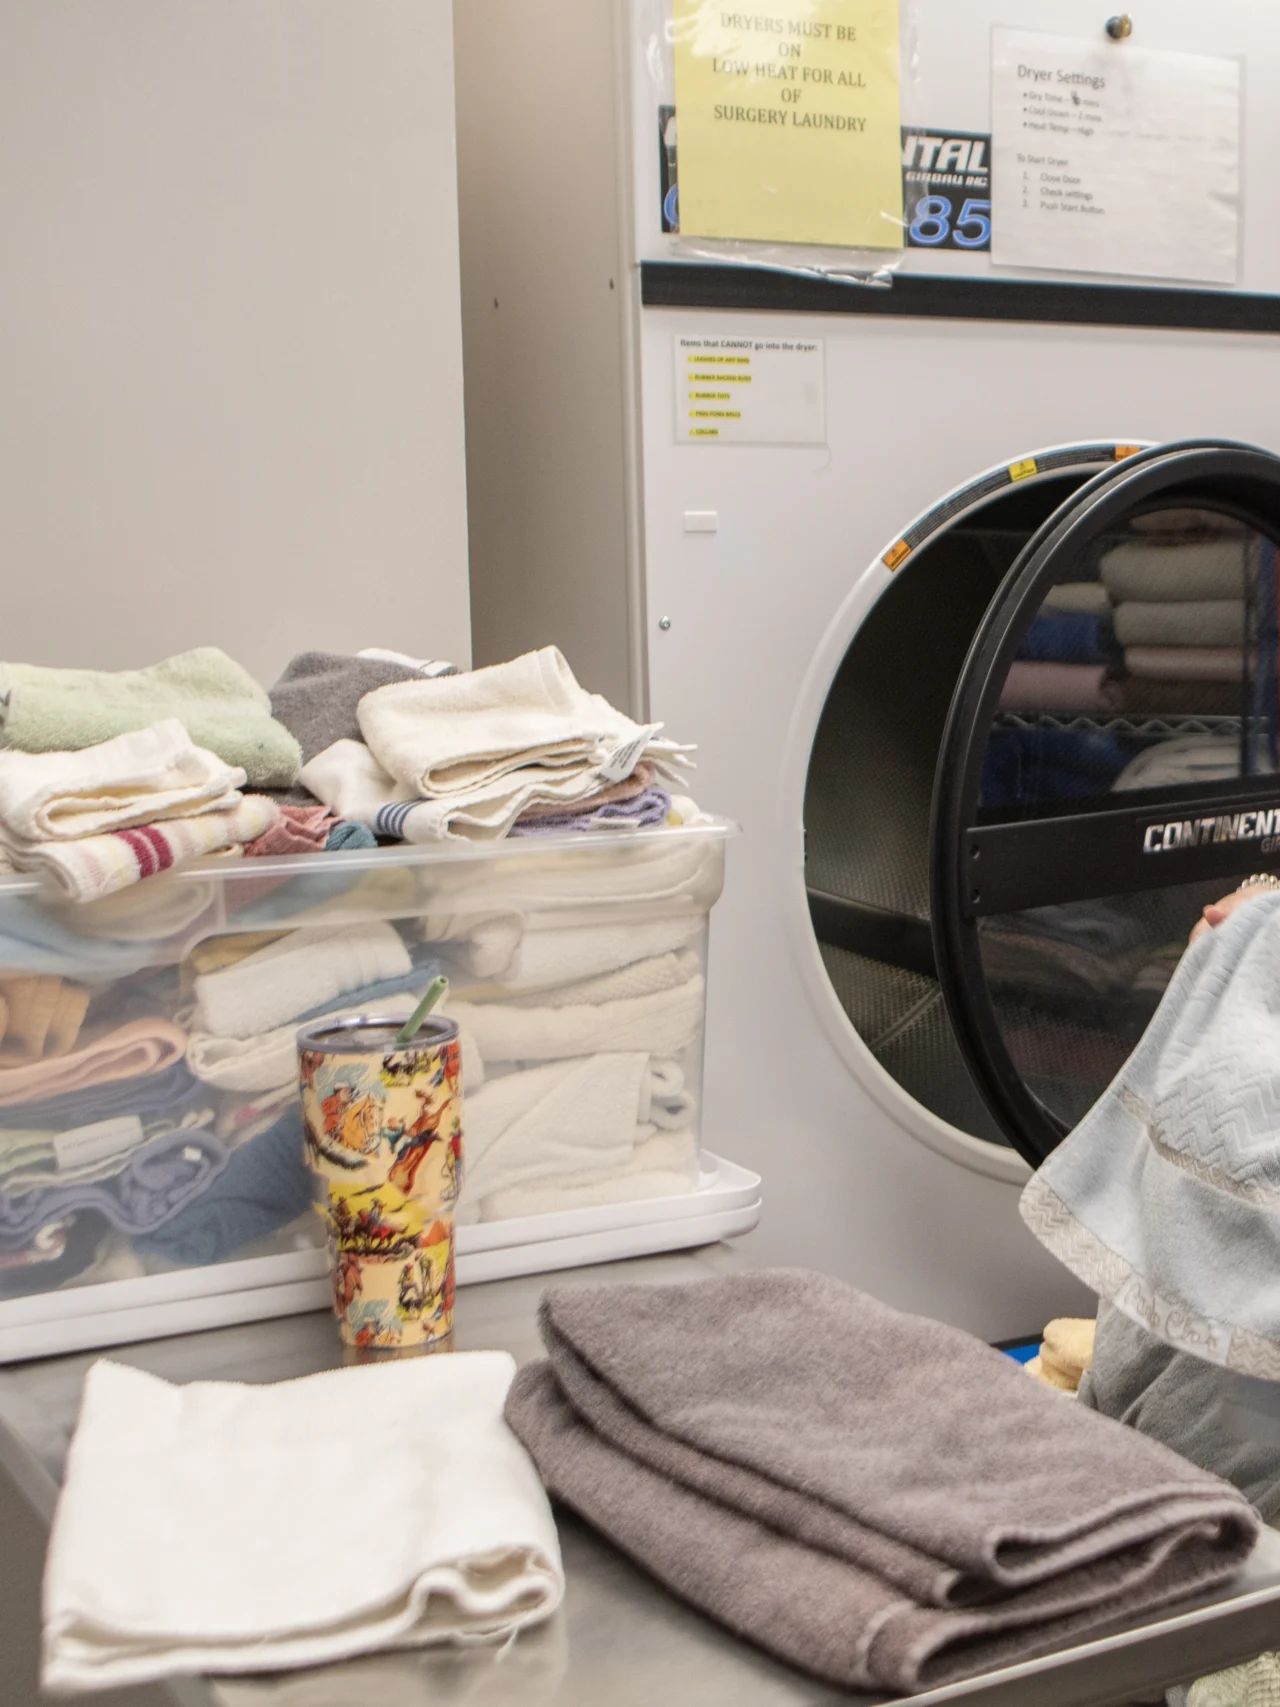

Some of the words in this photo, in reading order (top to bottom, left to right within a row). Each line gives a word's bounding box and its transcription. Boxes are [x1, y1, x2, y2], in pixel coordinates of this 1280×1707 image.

[721, 13, 783, 34] DRYERS
[789, 20, 832, 38] MUST
[837, 25, 856, 41] BE
[779, 42, 800, 57] ON
[713, 58, 749, 75] LOW
[755, 63, 797, 81] HEAT
[803, 67, 833, 84] FOR
[838, 71, 866, 87] ALL
[1017, 64, 1052, 82] Dryer
[1056, 69, 1105, 90] Settings
[781, 88, 801, 104] OF
[714, 105, 787, 125] SURGERY
[793, 112, 866, 132] LAUNDRY
[680, 338, 701, 348] Items
[703, 339, 719, 348] that
[720, 340, 752, 349] CANNOT
[754, 342, 764, 351] go
[765, 341, 780, 350] into
[782, 342, 794, 351] the
